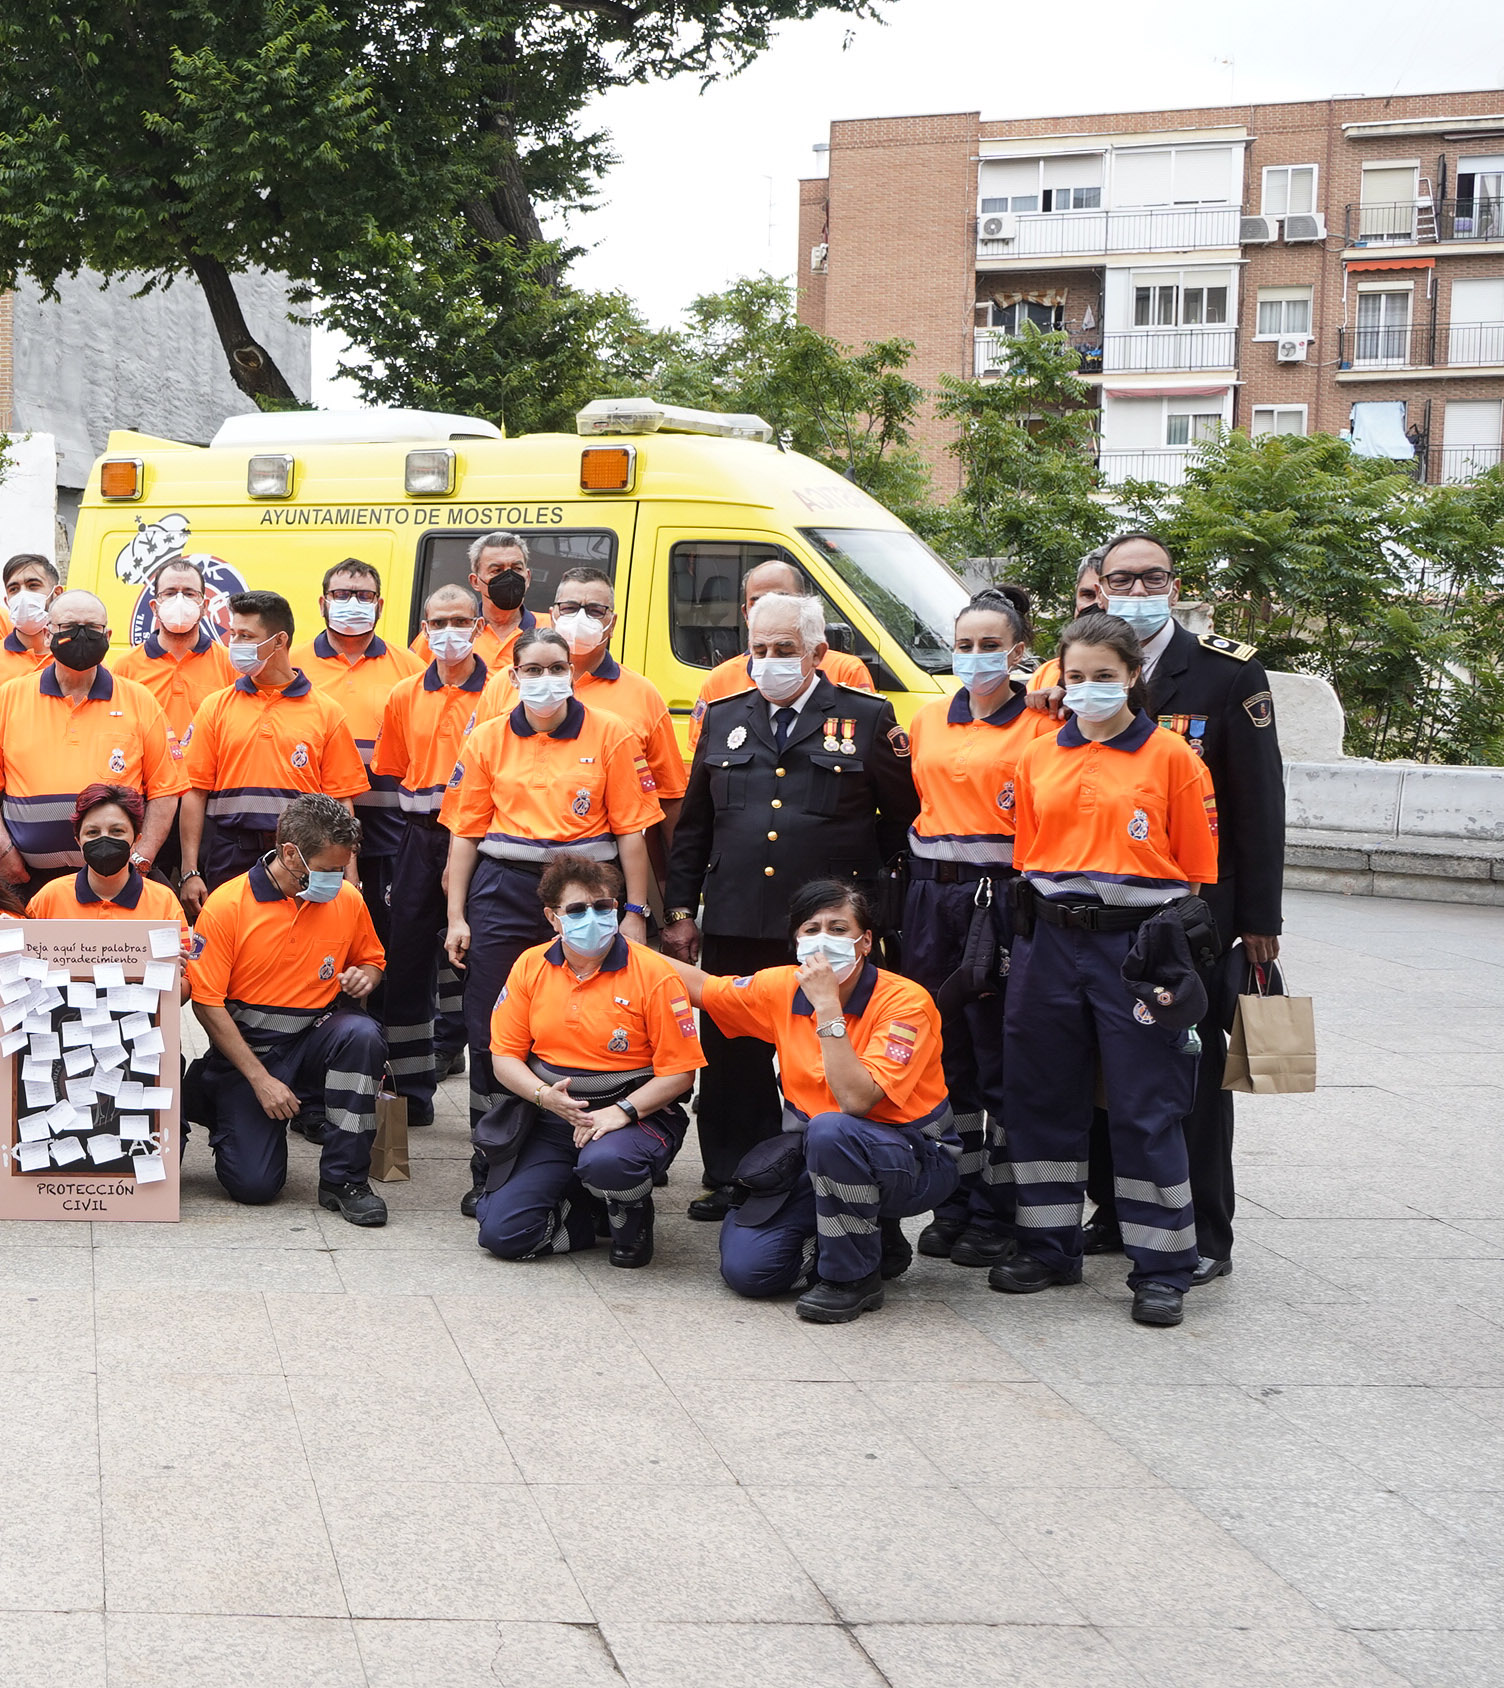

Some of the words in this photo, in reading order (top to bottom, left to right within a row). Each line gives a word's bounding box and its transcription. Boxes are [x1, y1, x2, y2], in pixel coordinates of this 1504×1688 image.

[260, 508, 409, 525] AYUNTAMIENTO
[414, 509, 441, 525] DE
[447, 507, 564, 524] MOSTOLES
[134, 613, 145, 645] CIVIL
[26, 942, 49, 956] Deja
[53, 942, 76, 956] aquí
[80, 943, 97, 952] tus
[101, 942, 147, 957] palabras
[52, 954, 138, 966] agradecimiento
[36, 1180, 134, 1196] PROTECCIÓN
[62, 1199, 108, 1211] CIVIL
